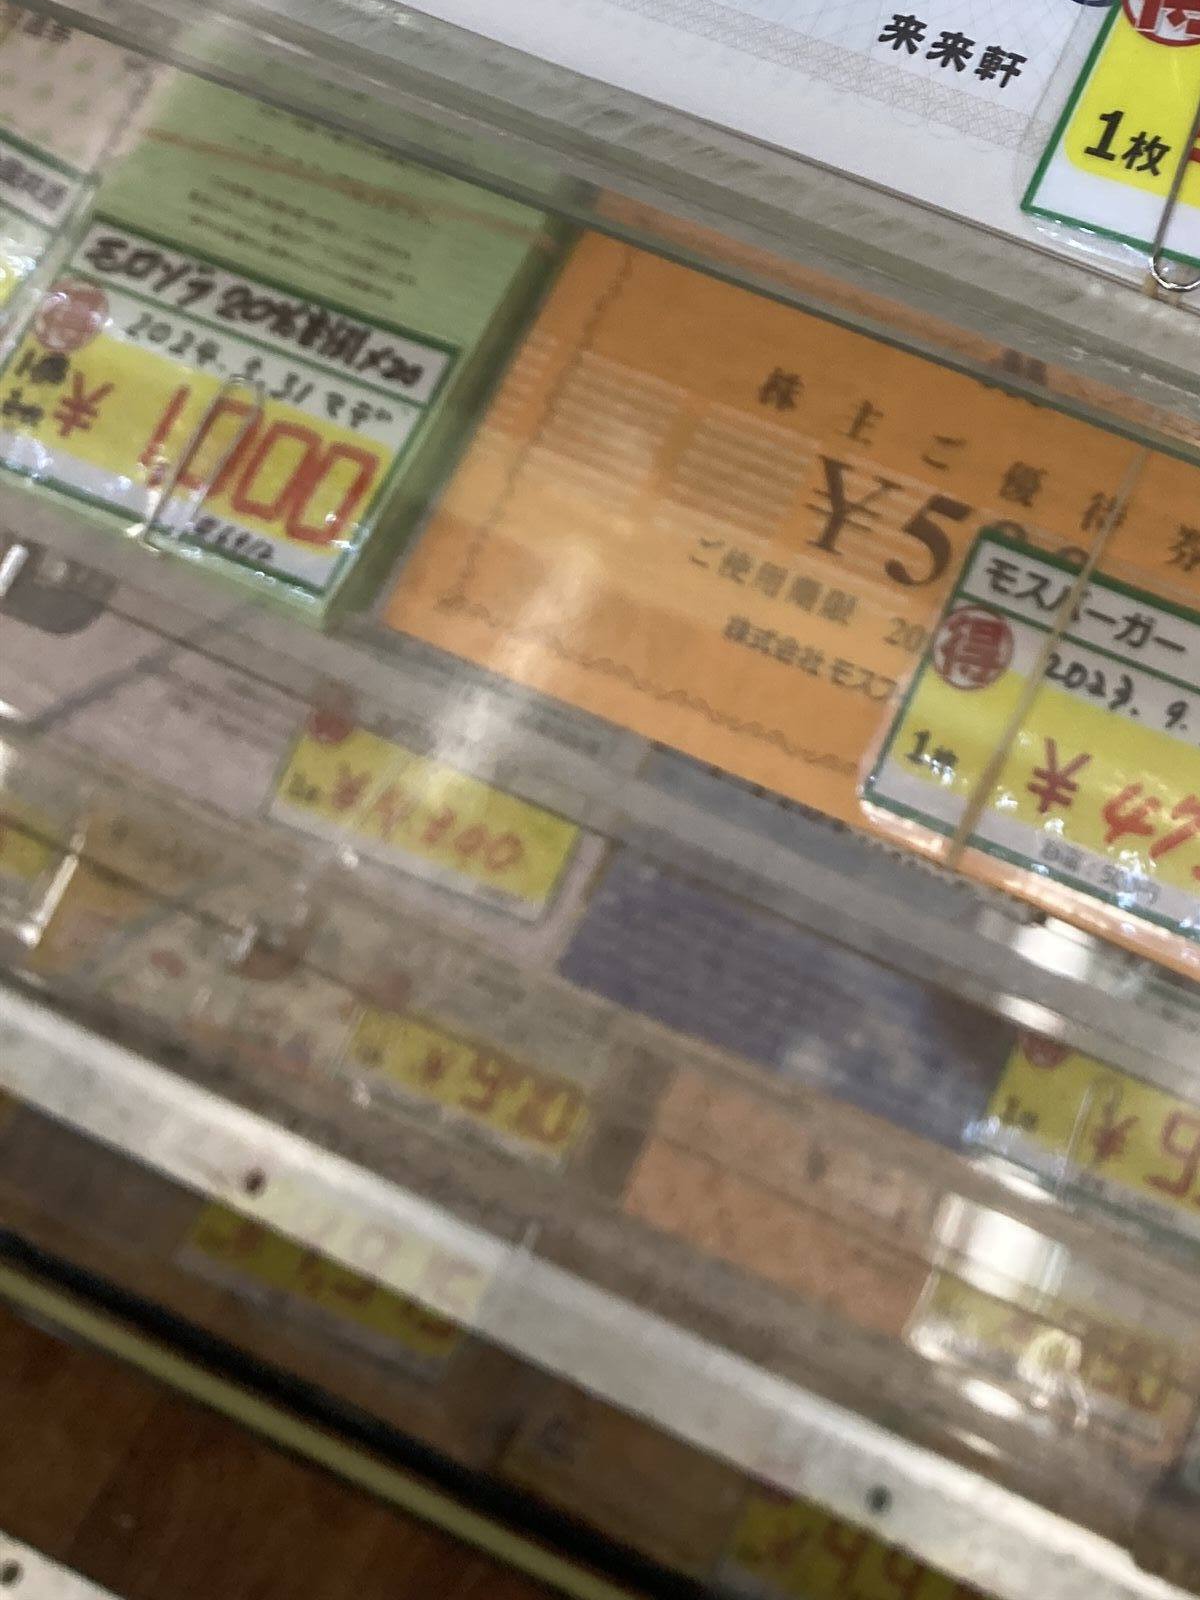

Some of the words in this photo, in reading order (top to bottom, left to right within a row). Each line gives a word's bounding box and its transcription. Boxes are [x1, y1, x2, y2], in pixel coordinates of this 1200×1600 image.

[876, 11, 1030, 91] 来来軒
[1081, 108, 1174, 178] 1枚
[984, 555, 1188, 657] モスバーガー
[932, 606, 1014, 689] 得
